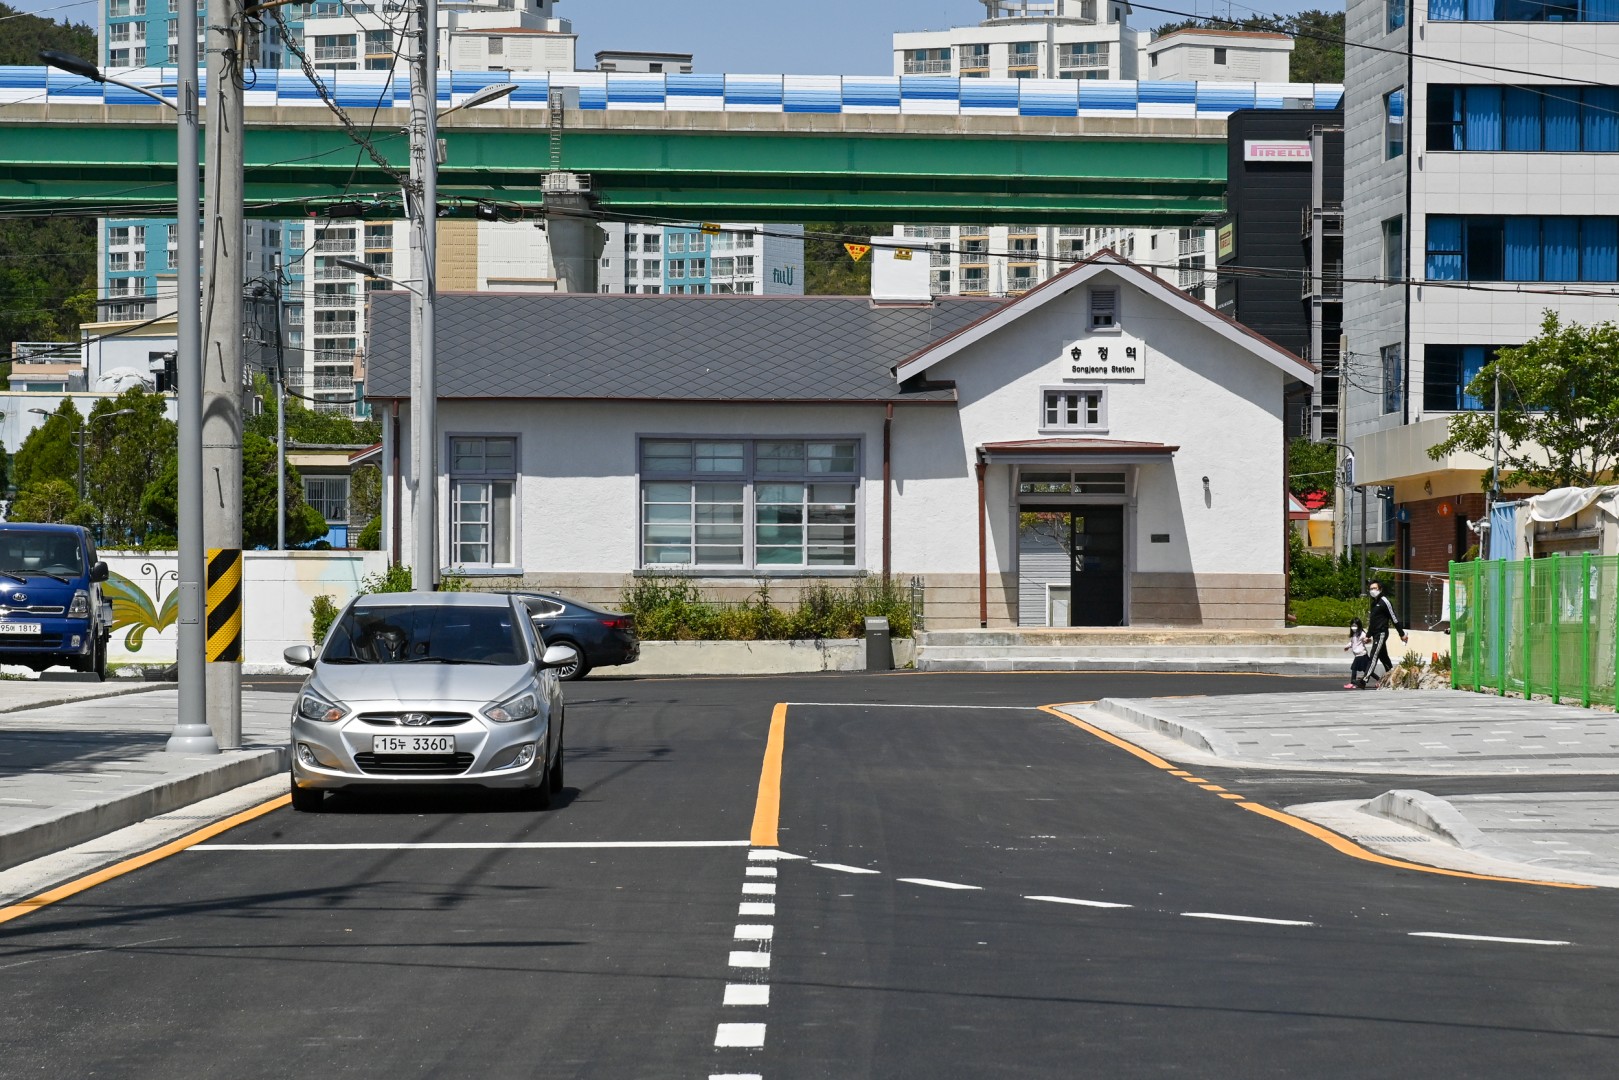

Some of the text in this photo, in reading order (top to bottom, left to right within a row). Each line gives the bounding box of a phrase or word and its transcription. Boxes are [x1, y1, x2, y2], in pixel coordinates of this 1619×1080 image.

[1250, 144, 1311, 157] PIRELLI
[1072, 365, 1135, 374] Songjeong Station
[19, 624, 37, 632] 1812
[381, 738, 447, 750] 15누 3360
